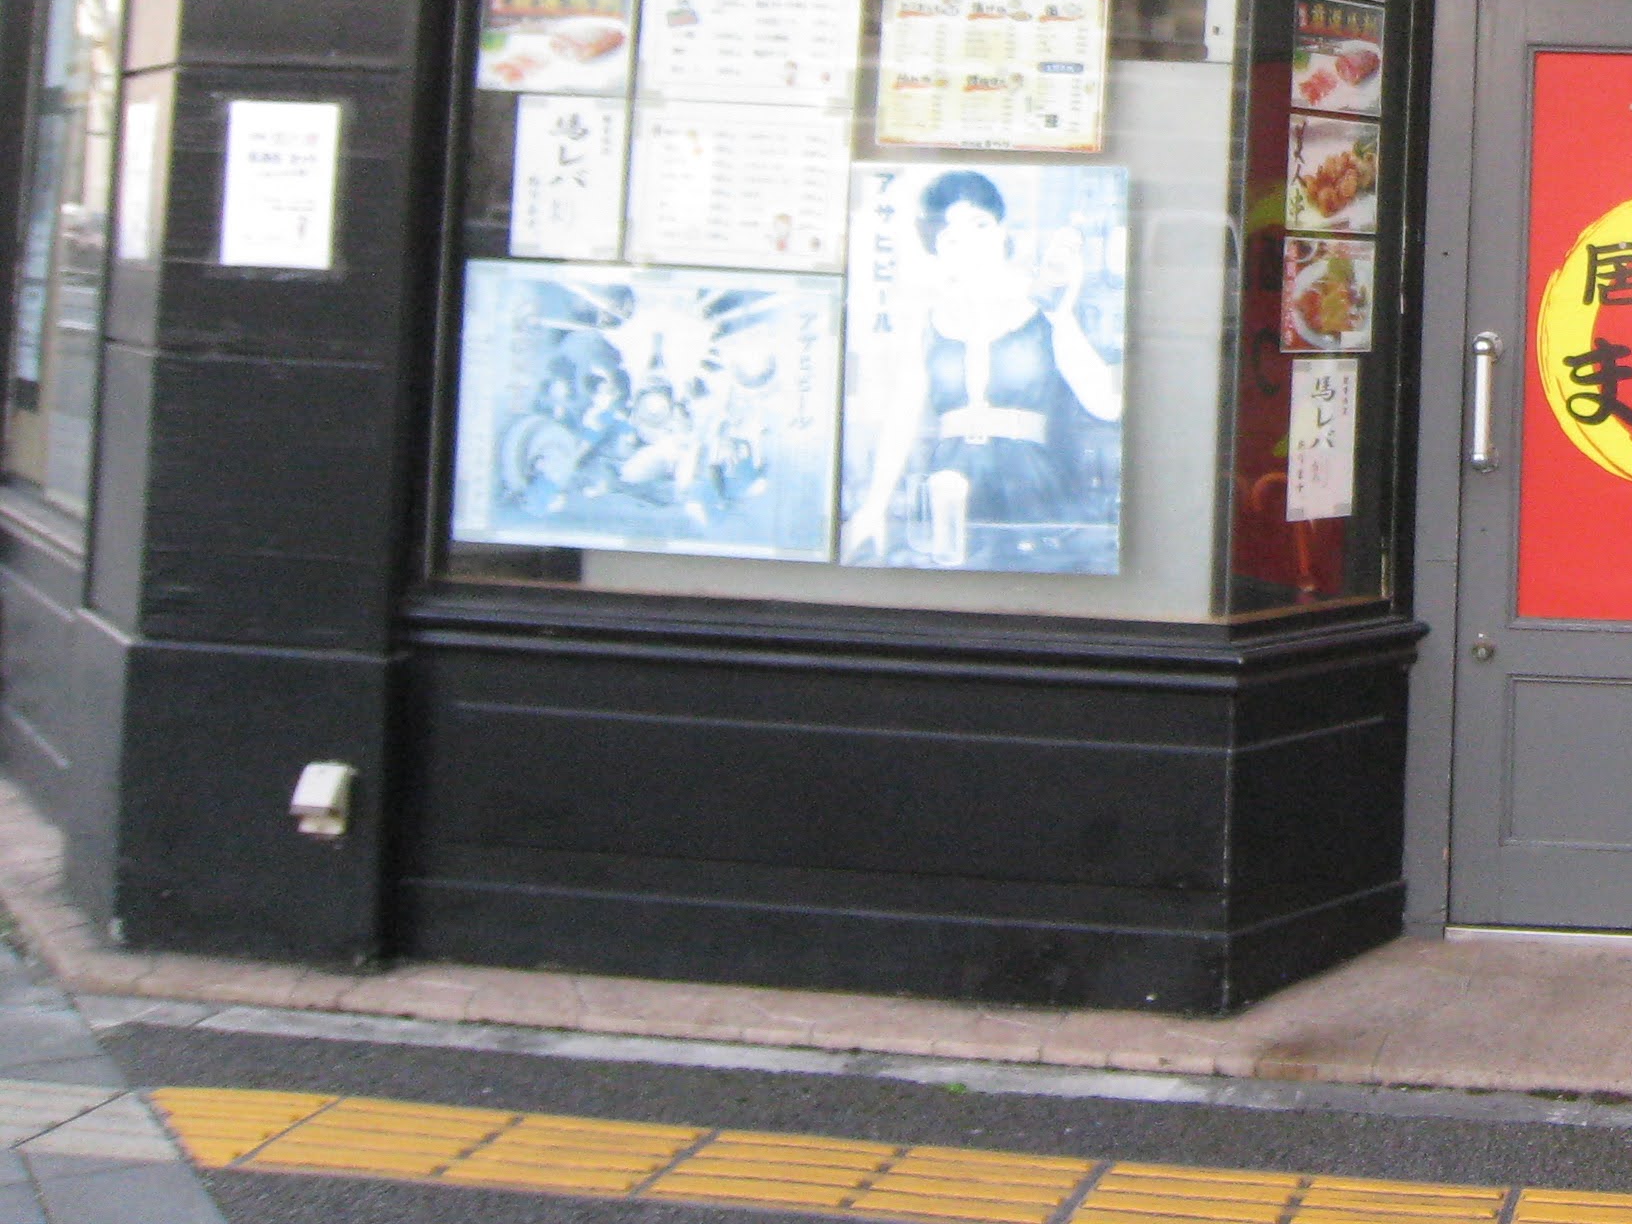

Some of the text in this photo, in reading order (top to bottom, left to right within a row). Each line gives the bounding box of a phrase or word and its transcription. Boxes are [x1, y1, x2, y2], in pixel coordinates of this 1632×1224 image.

[873, 173, 897, 333] アサヒビール
